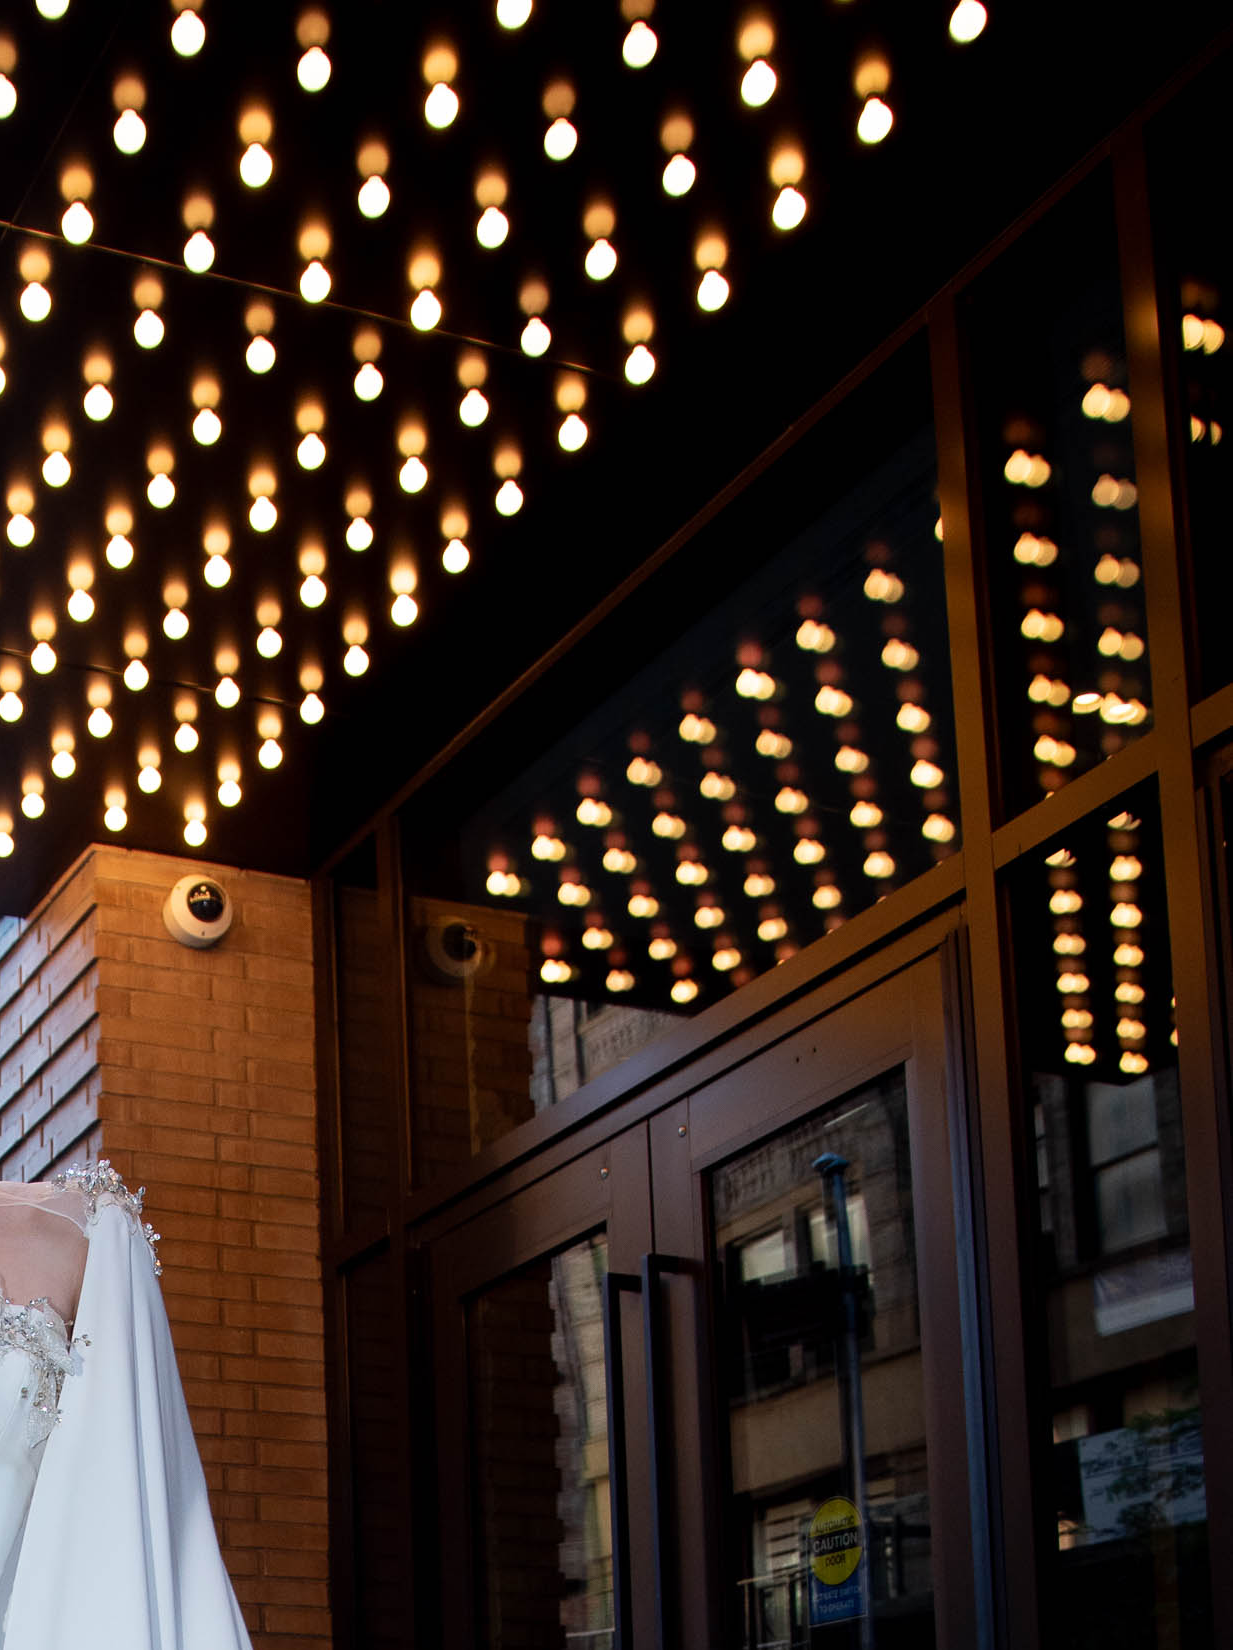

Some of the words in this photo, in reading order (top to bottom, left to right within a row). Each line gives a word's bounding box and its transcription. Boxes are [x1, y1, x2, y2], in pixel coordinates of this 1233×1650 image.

[815, 1515, 855, 1534] AUTOMATIC
[813, 1532, 858, 1552] CAUTION
[825, 1554, 846, 1568] DOOR
